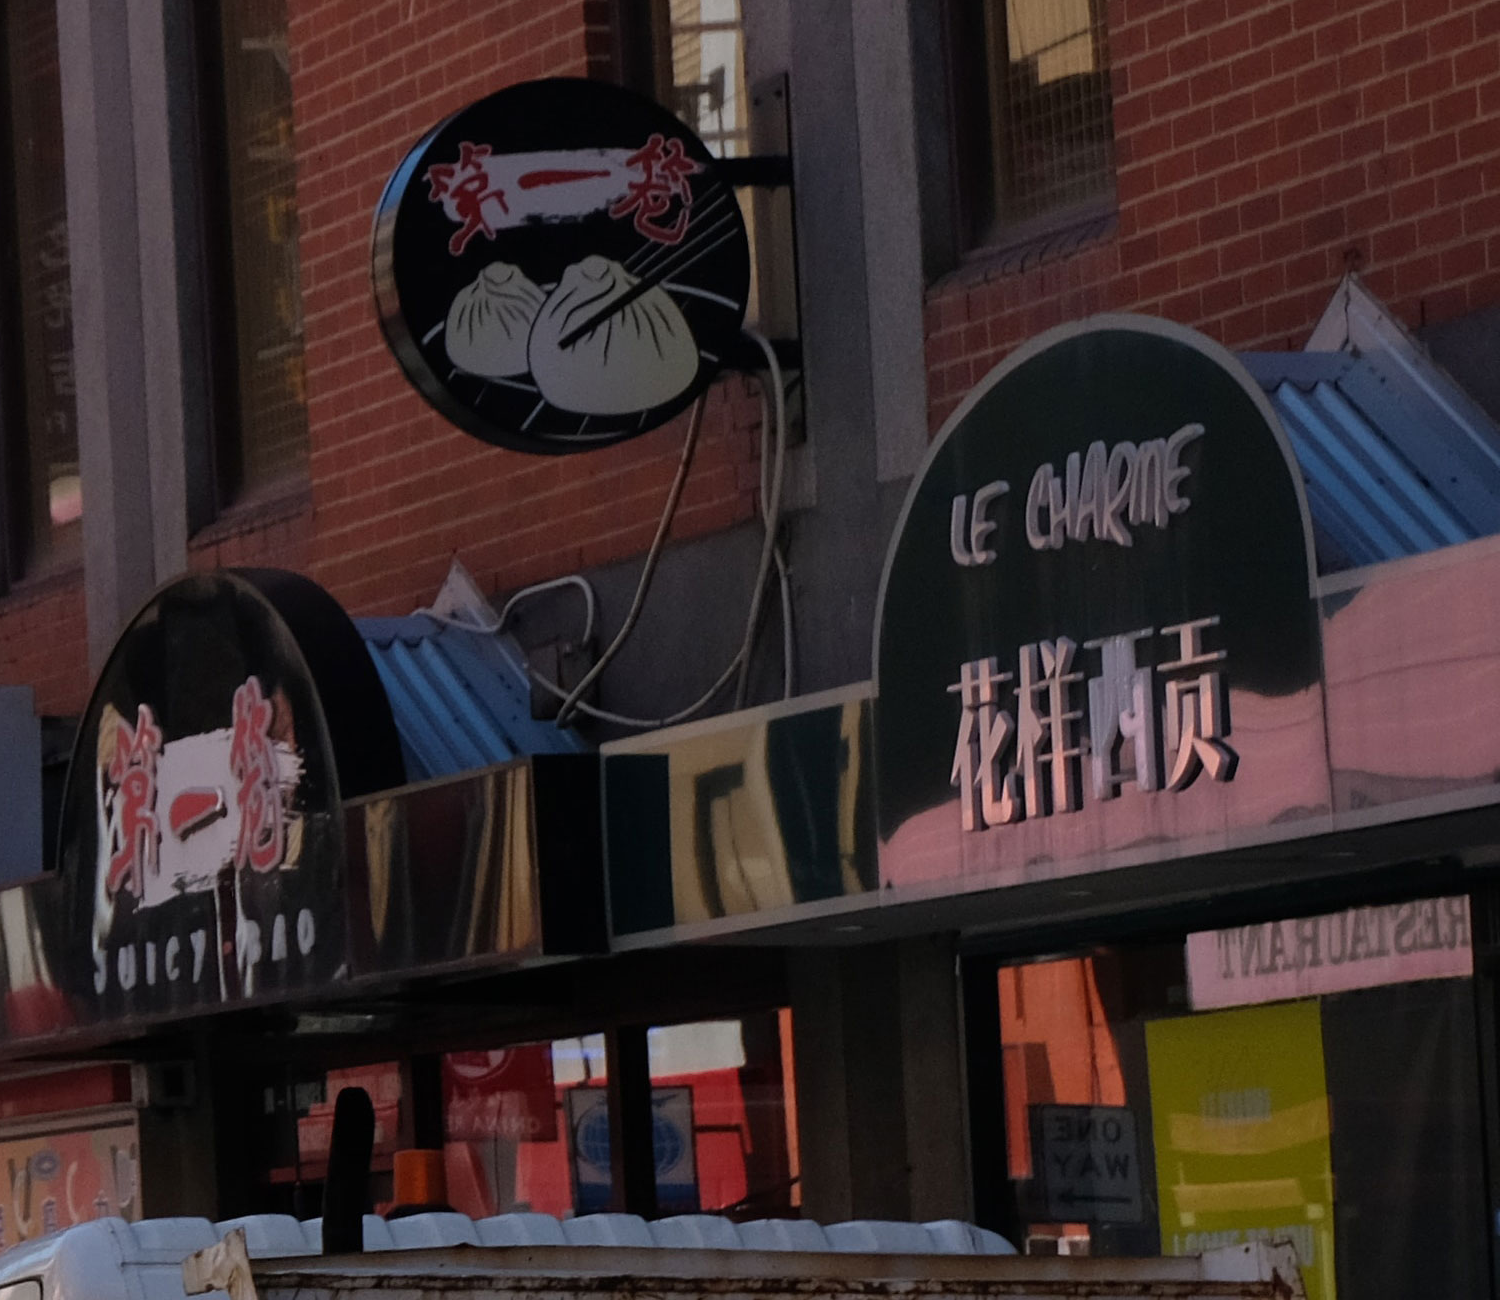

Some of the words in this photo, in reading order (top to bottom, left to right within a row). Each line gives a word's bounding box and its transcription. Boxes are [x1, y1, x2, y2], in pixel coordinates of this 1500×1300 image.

[950, 479, 1010, 568] LE
[1024, 422, 1206, 552] CHARME
[93, 928, 207, 995] JUICY
